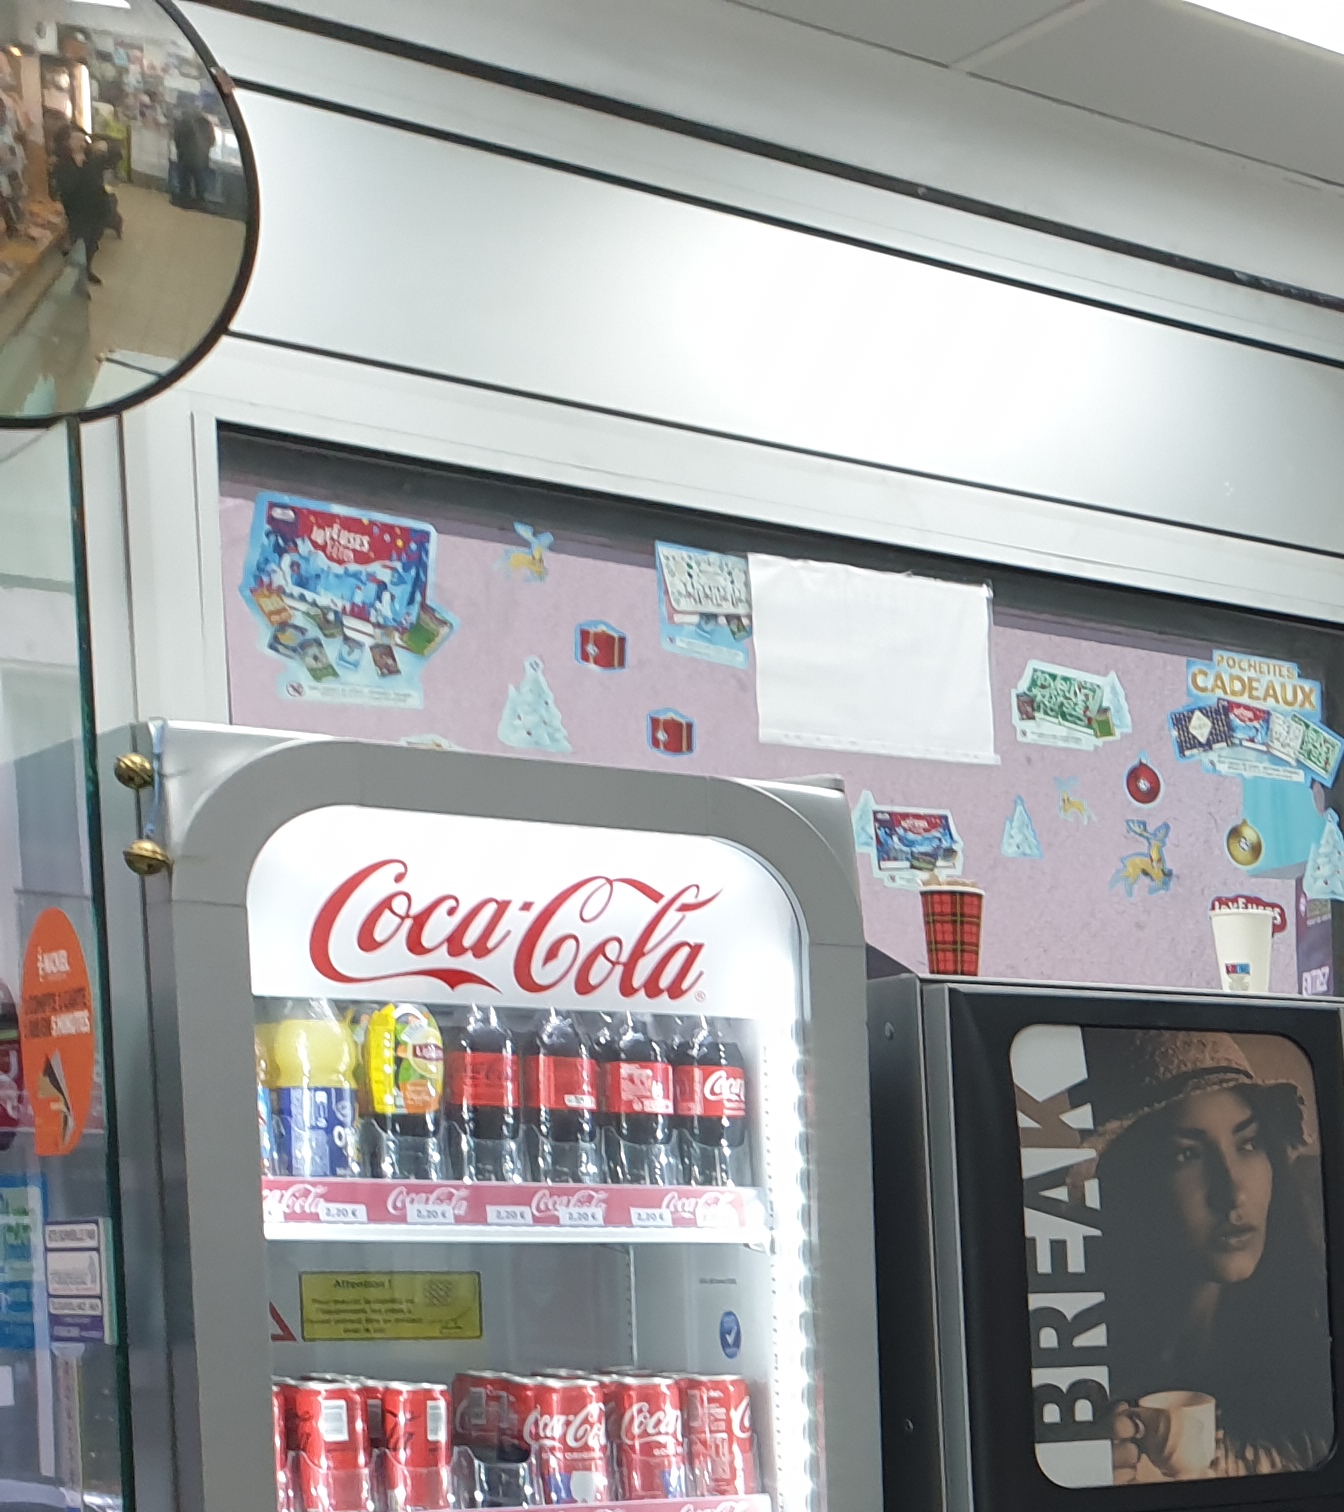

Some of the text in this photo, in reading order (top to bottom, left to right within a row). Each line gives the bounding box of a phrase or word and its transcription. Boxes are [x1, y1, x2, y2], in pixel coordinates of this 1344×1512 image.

[1190, 667, 1318, 712] CADEAUX
[1216, 653, 1297, 680] POCHETTES
[308, 858, 724, 1004] Coca-Cola
[1014, 1075, 1113, 1442] BREAK
